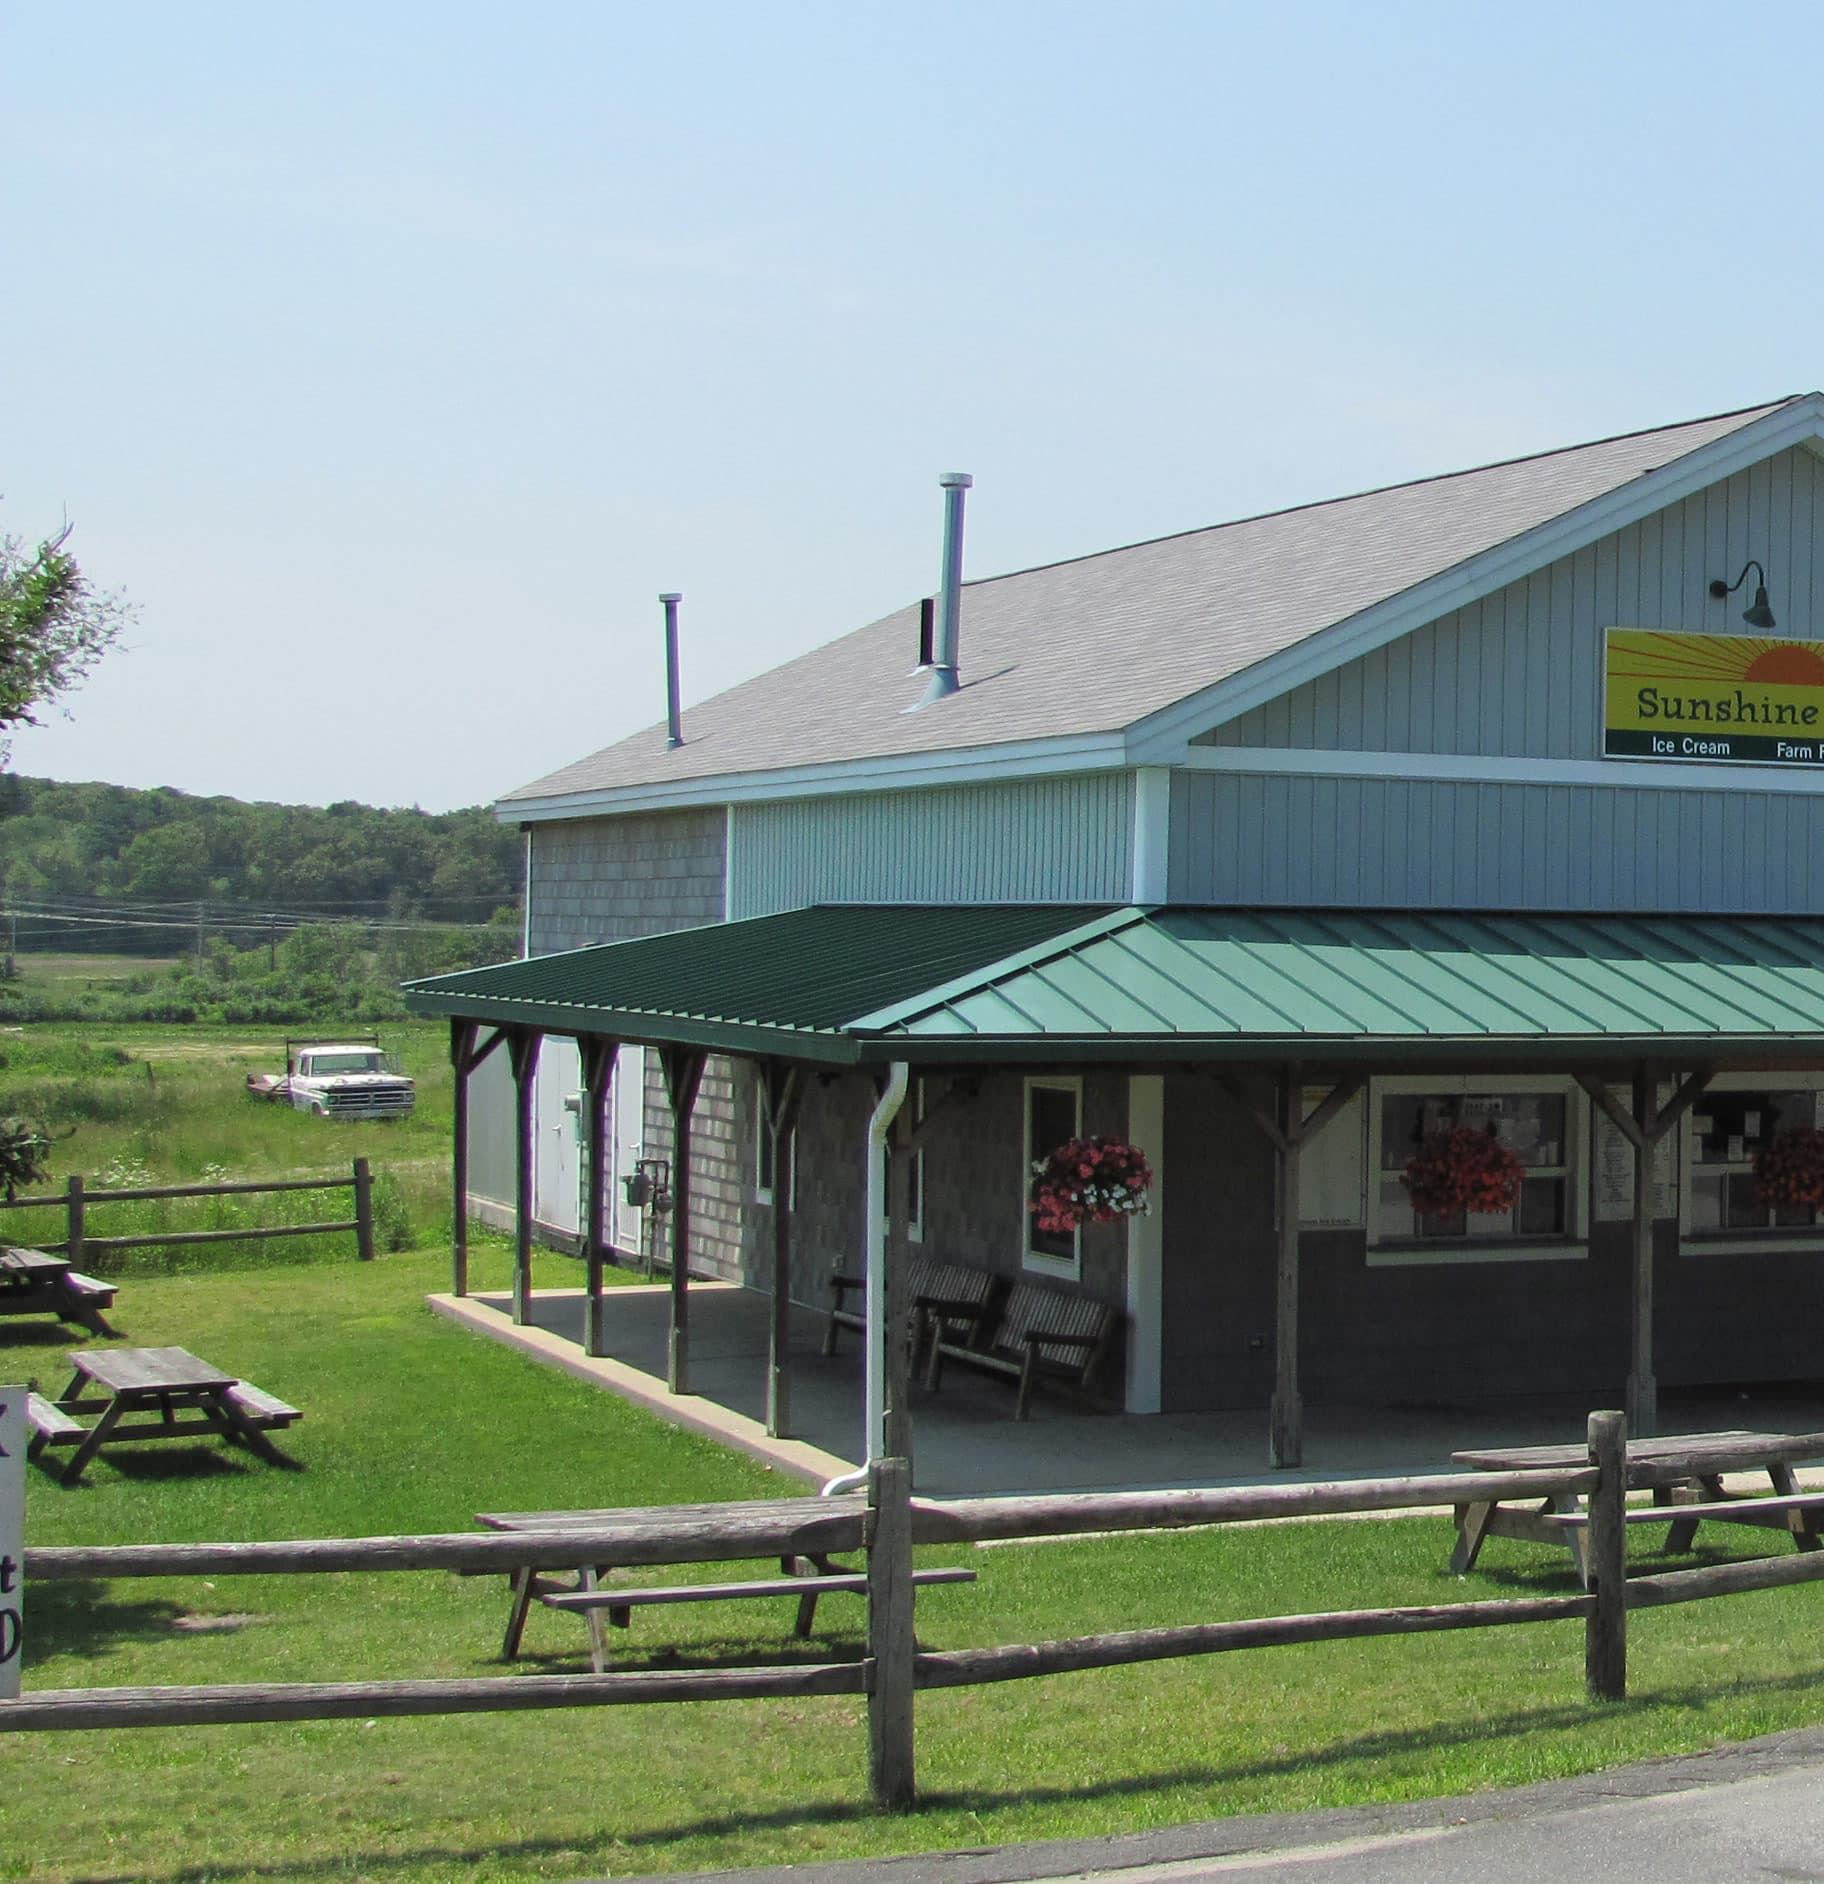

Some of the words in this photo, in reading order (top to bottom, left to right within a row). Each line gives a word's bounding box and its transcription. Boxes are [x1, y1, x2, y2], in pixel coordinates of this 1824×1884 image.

[1637, 687, 1820, 726] Sunshine
[1652, 736, 1676, 753] Ice
[1682, 737, 1731, 756] Cream
[1777, 742, 1813, 760] Farm
